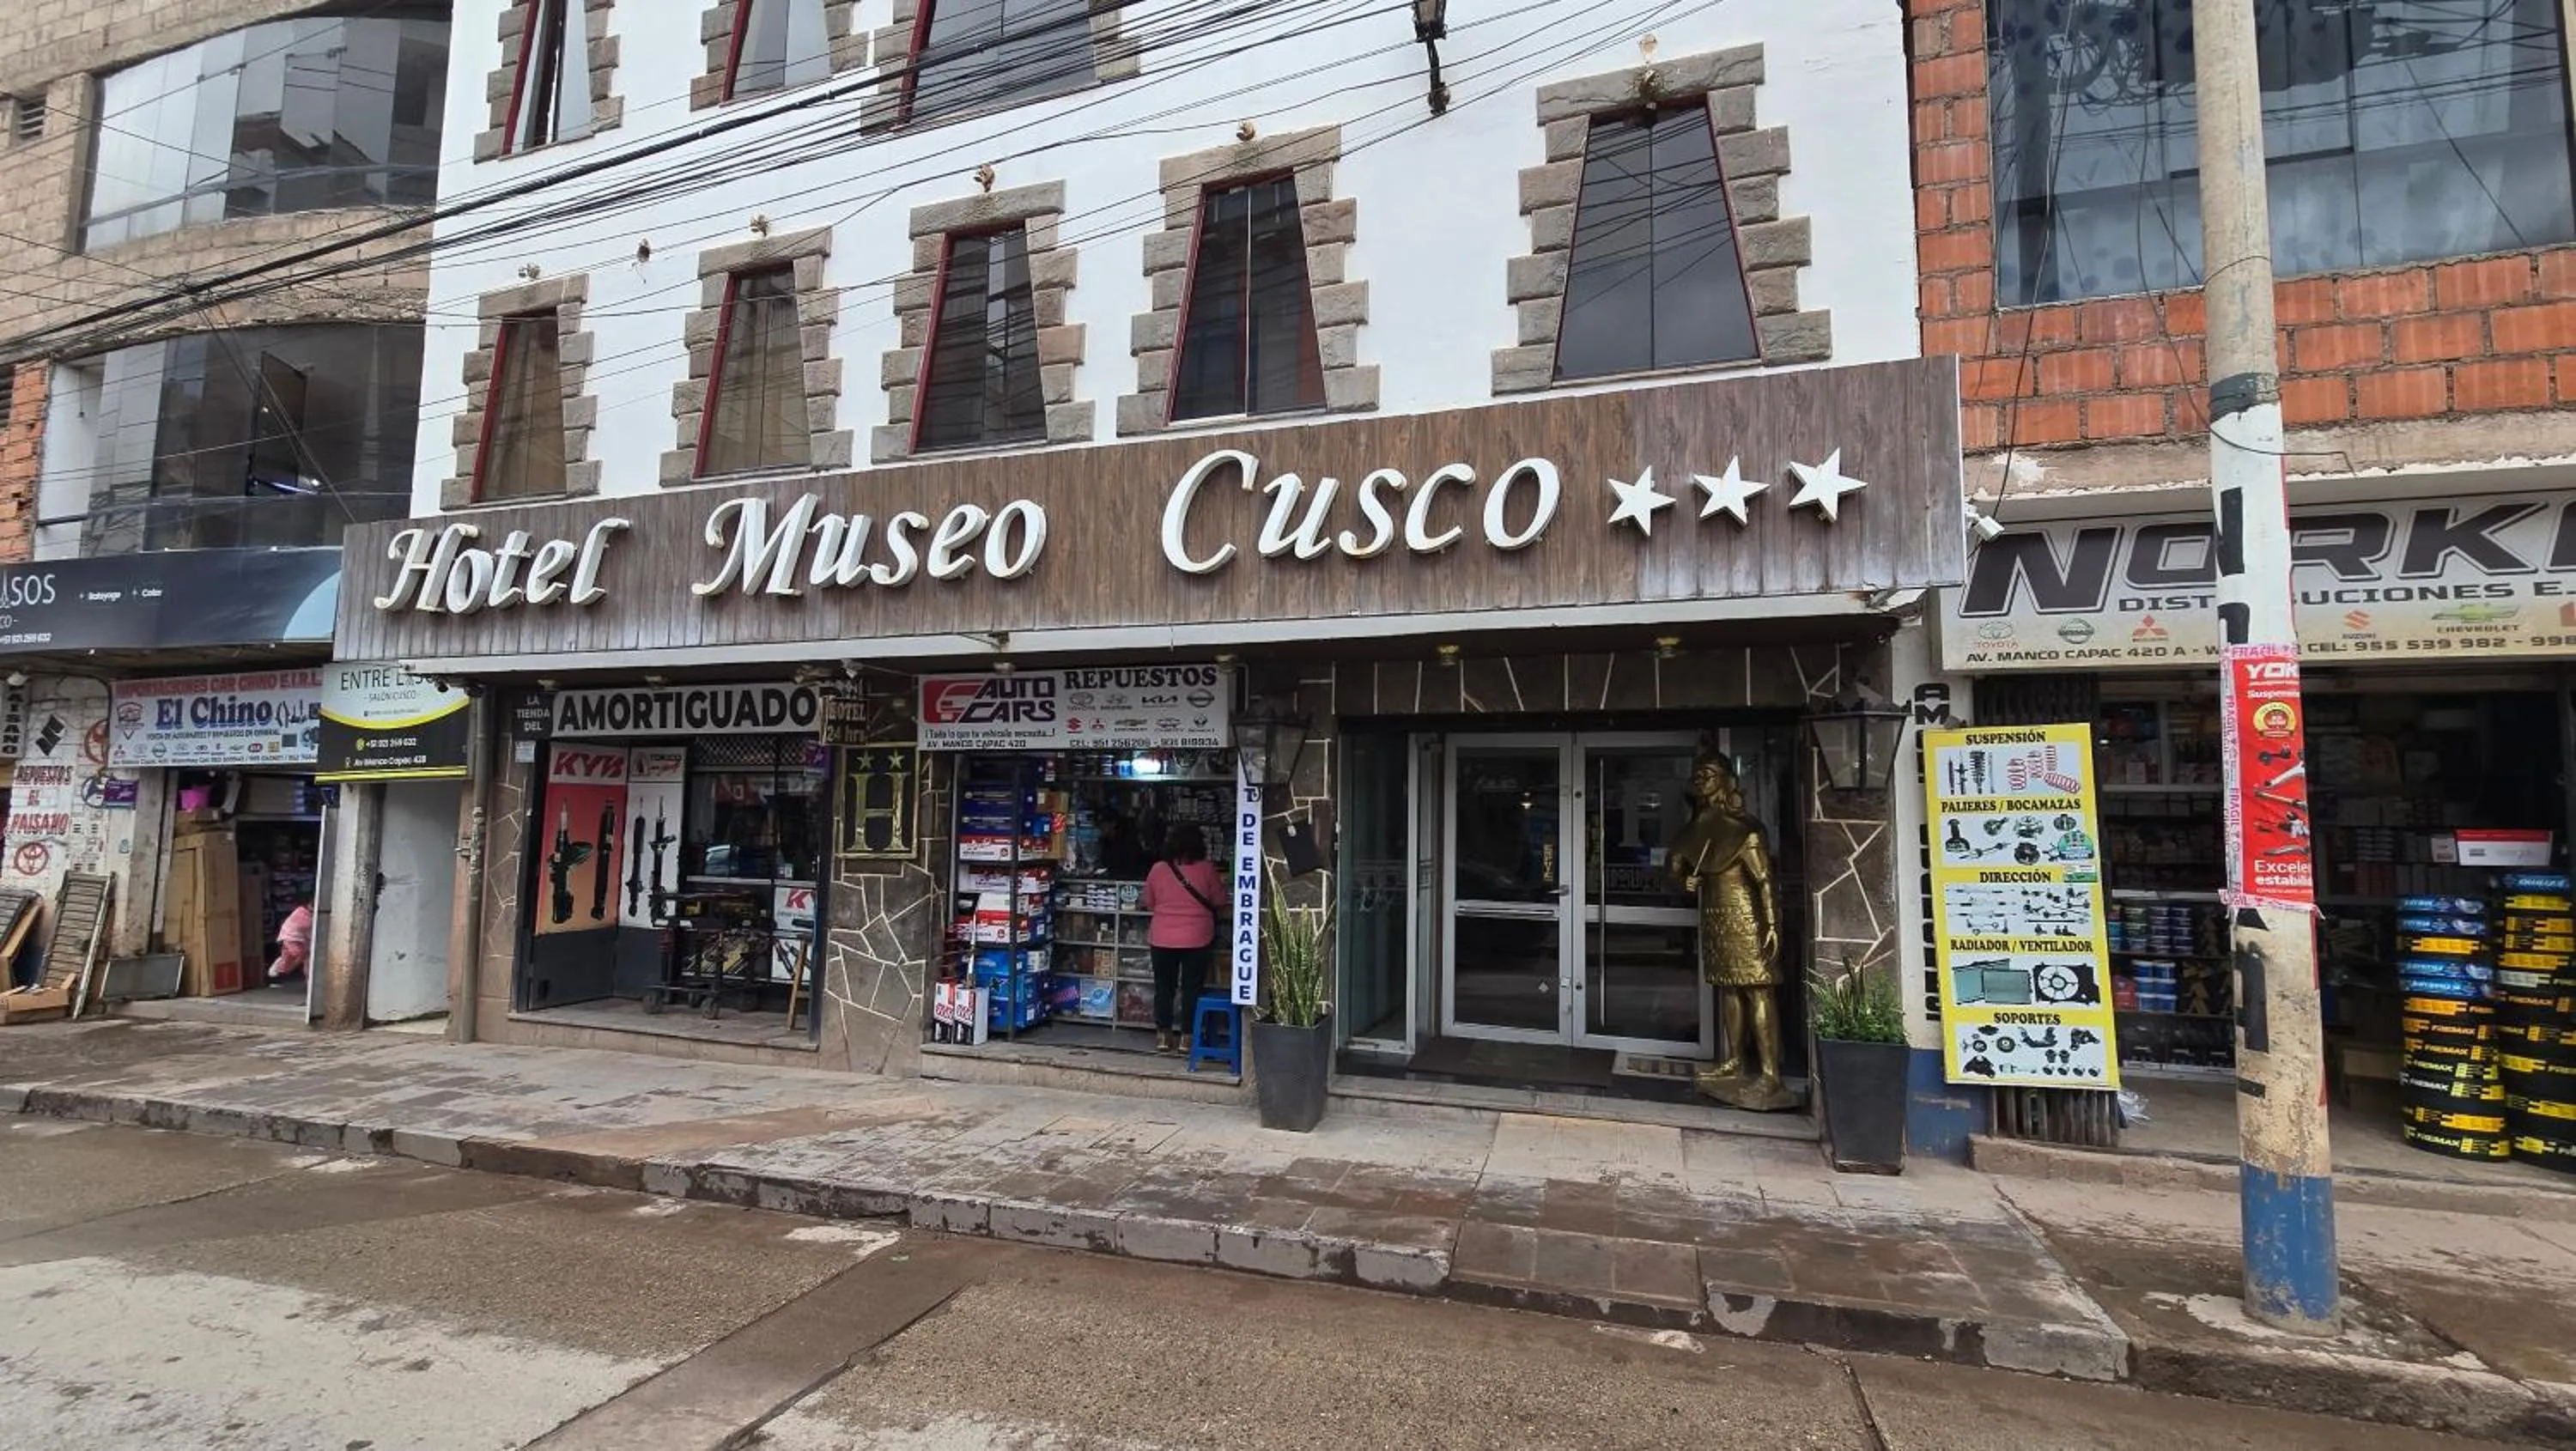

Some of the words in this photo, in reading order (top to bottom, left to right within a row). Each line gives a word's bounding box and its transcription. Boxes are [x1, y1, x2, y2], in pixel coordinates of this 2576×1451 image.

[374, 517, 630, 616] Hotel
[692, 493, 1047, 598] Museo
[1160, 449, 1560, 574] Cusco
[1959, 501, 2576, 617] NORK
[2119, 582, 2514, 612] DISTUCIONES
[2437, 625, 2519, 634] CHEVROLET
[1966, 652, 1993, 662] AV.
[1998, 649, 2060, 661] MANCO
[2065, 647, 2121, 659] CAPAC
[2128, 647, 2166, 658] 420
[2173, 647, 2186, 656] A
[2354, 641, 2397, 652] 955
[2407, 640, 2451, 651] 539
[2460, 638, 2506, 648] 982
[341, 668, 392, 691] ENTRE
[975, 677, 1056, 700] AUTO
[1065, 666, 1218, 689] REPUESTOS
[156, 697, 184, 728] El
[190, 696, 273, 727] Chino
[526, 695, 540, 706] LA
[558, 686, 829, 731] AMORTIGUADO
[958, 700, 1056, 724] CARS
[516, 707, 550, 719] TIENDA
[524, 721, 543, 732] DEL
[1965, 730, 2046, 745] SUSPENSIÓN
[553, 751, 624, 779] KYB
[849, 773, 910, 851] H
[1941, 799, 1996, 813] PALIERES
[2006, 798, 2081, 811] BOCAMAZAS
[1978, 868, 2052, 883] DIRECCIÓN
[1237, 857, 1256, 1000] EMBRAGUE
[1950, 938, 2010, 951] RADIADOR
[2019, 938, 2093, 952] VENTILADOR
[1993, 1012, 2062, 1025] SOPORTES
